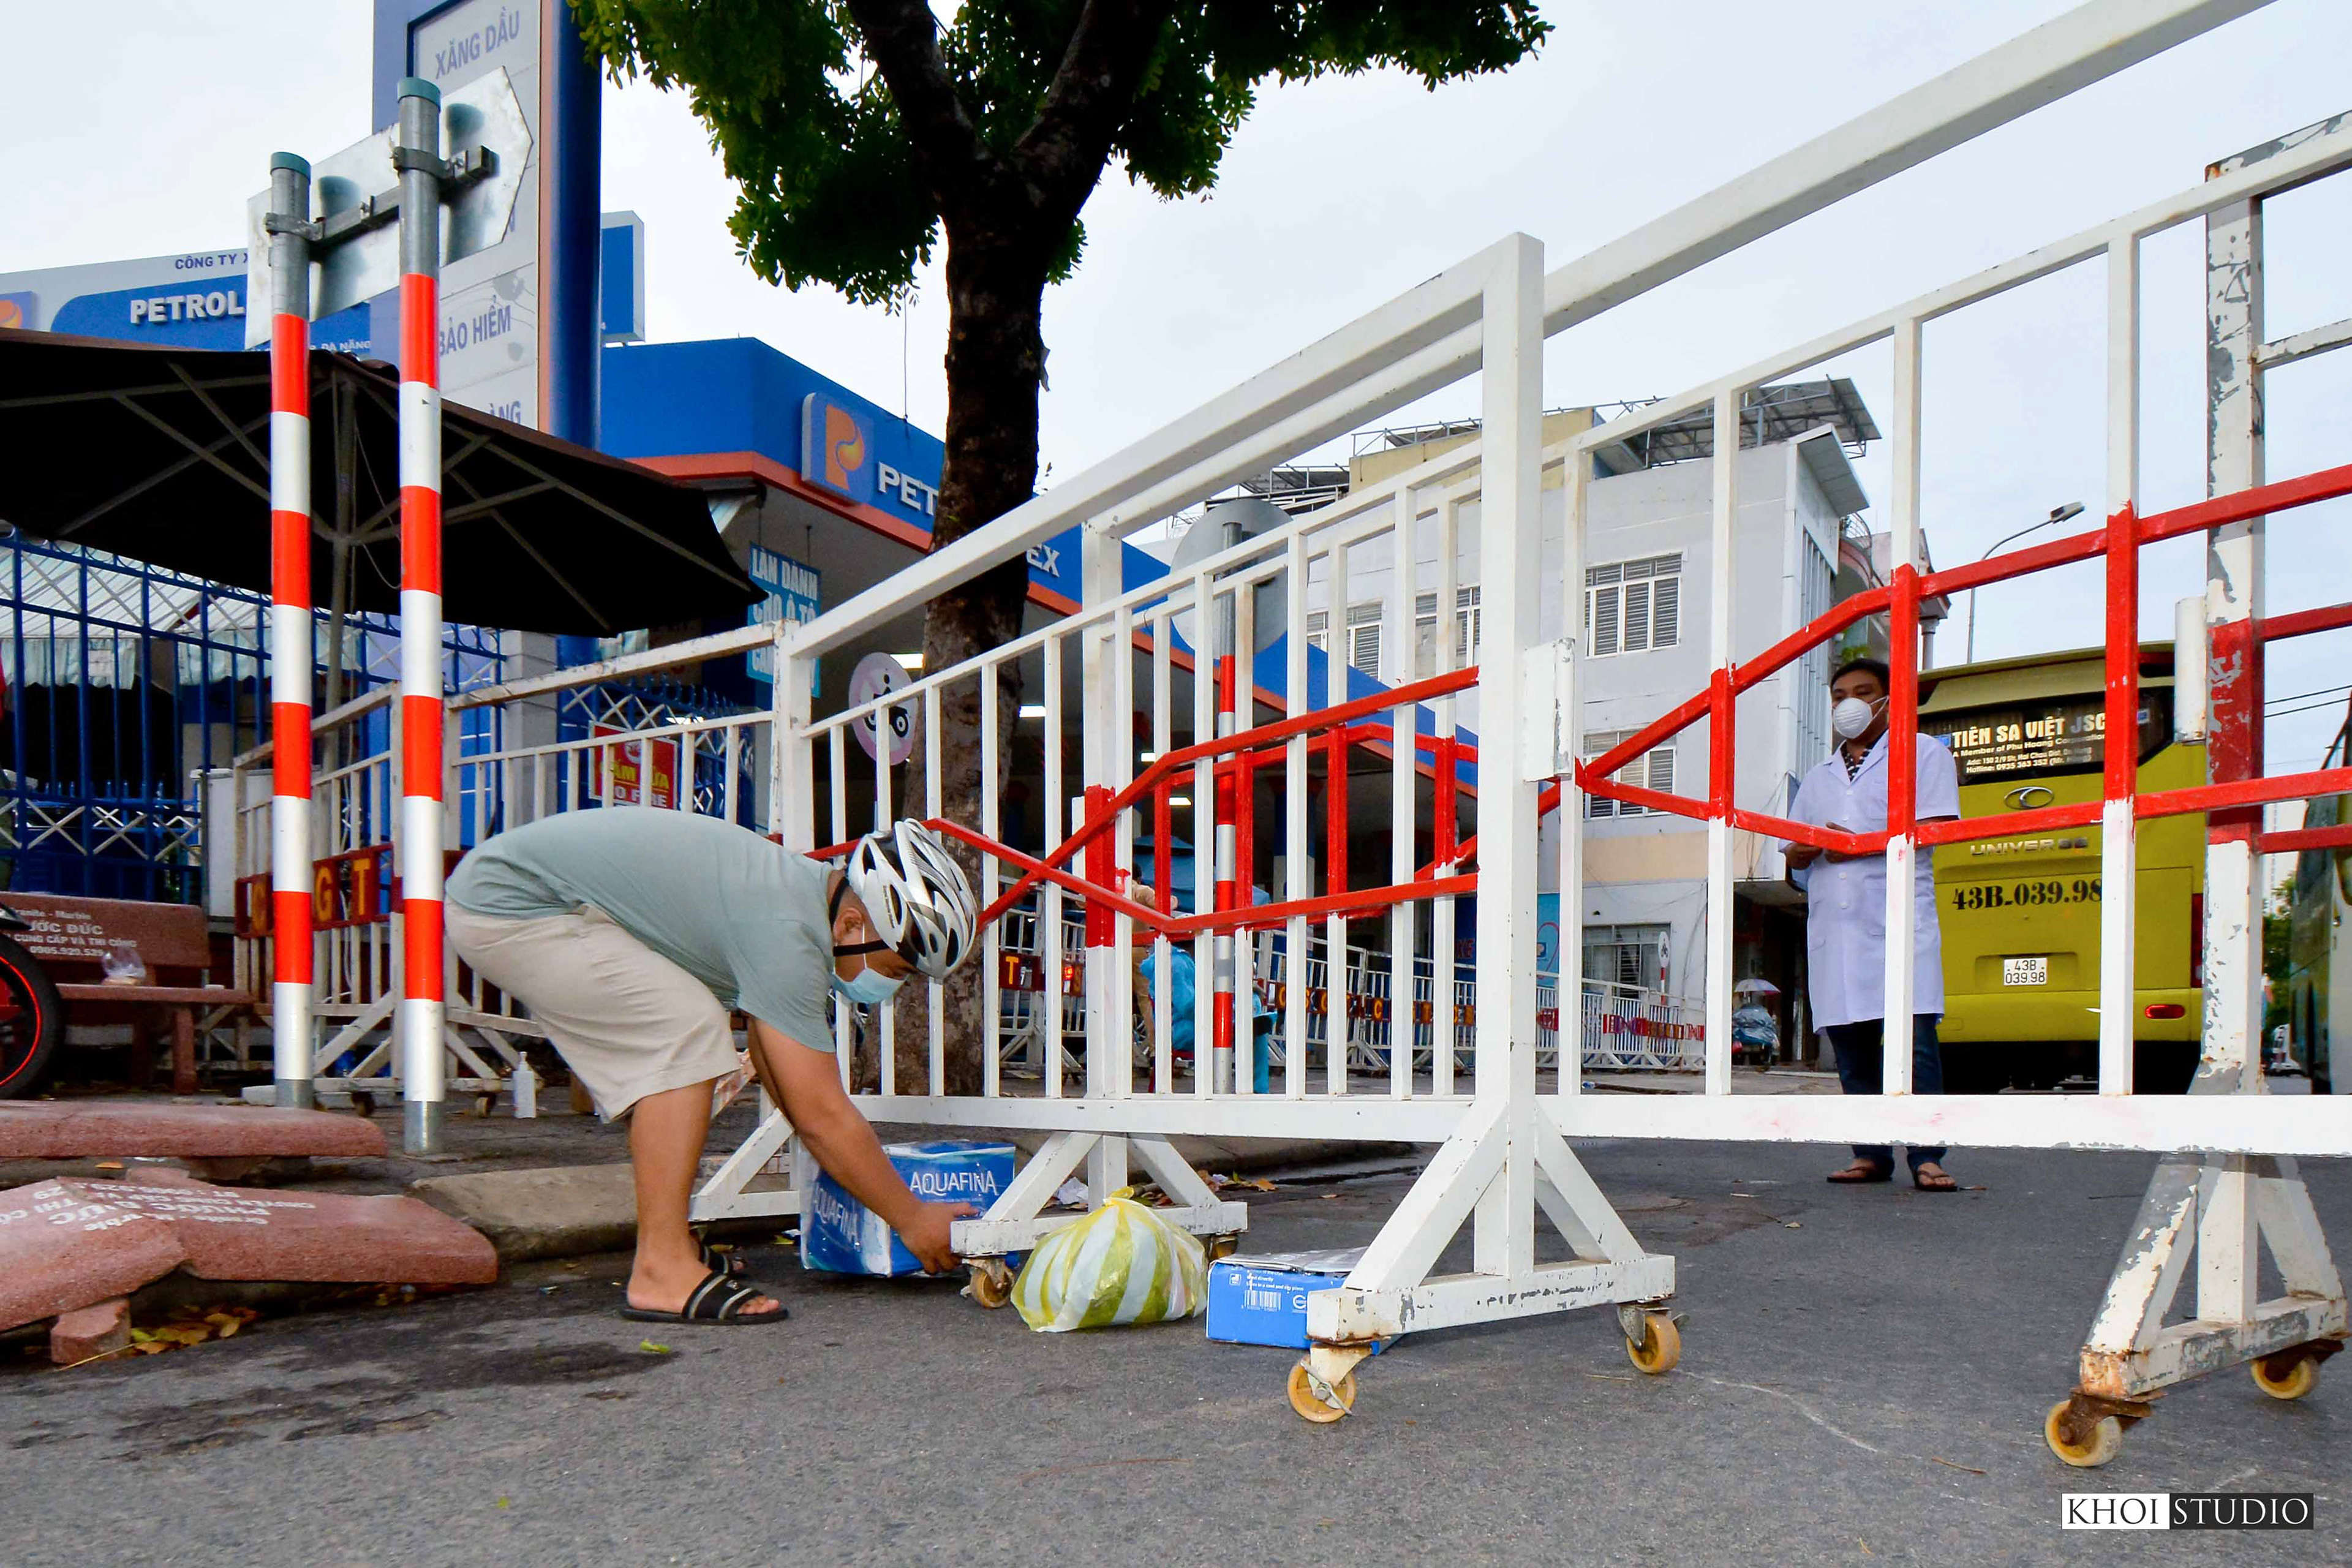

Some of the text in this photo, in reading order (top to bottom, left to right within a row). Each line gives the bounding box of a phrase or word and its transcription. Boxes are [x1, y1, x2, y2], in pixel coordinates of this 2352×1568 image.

[435, 6, 519, 80] XĂNG DẦU
[175, 255, 213, 270] CÔNG
[217, 254, 237, 265] TY
[130, 291, 246, 325] PETROL
[473, 294, 511, 344] HIỂM
[878, 461, 938, 516] PET
[1027, 544, 1060, 578] EX
[1952, 712, 2105, 748] TIÊN SA VIỆT JSC
[1961, 747, 1995, 756] Member
[2007, 742, 2023, 751] Phu
[1951, 878, 2102, 911] 43B-039.98
[2015, 960, 2037, 971] 43B
[910, 1170, 1000, 1196] AQUAFINA
